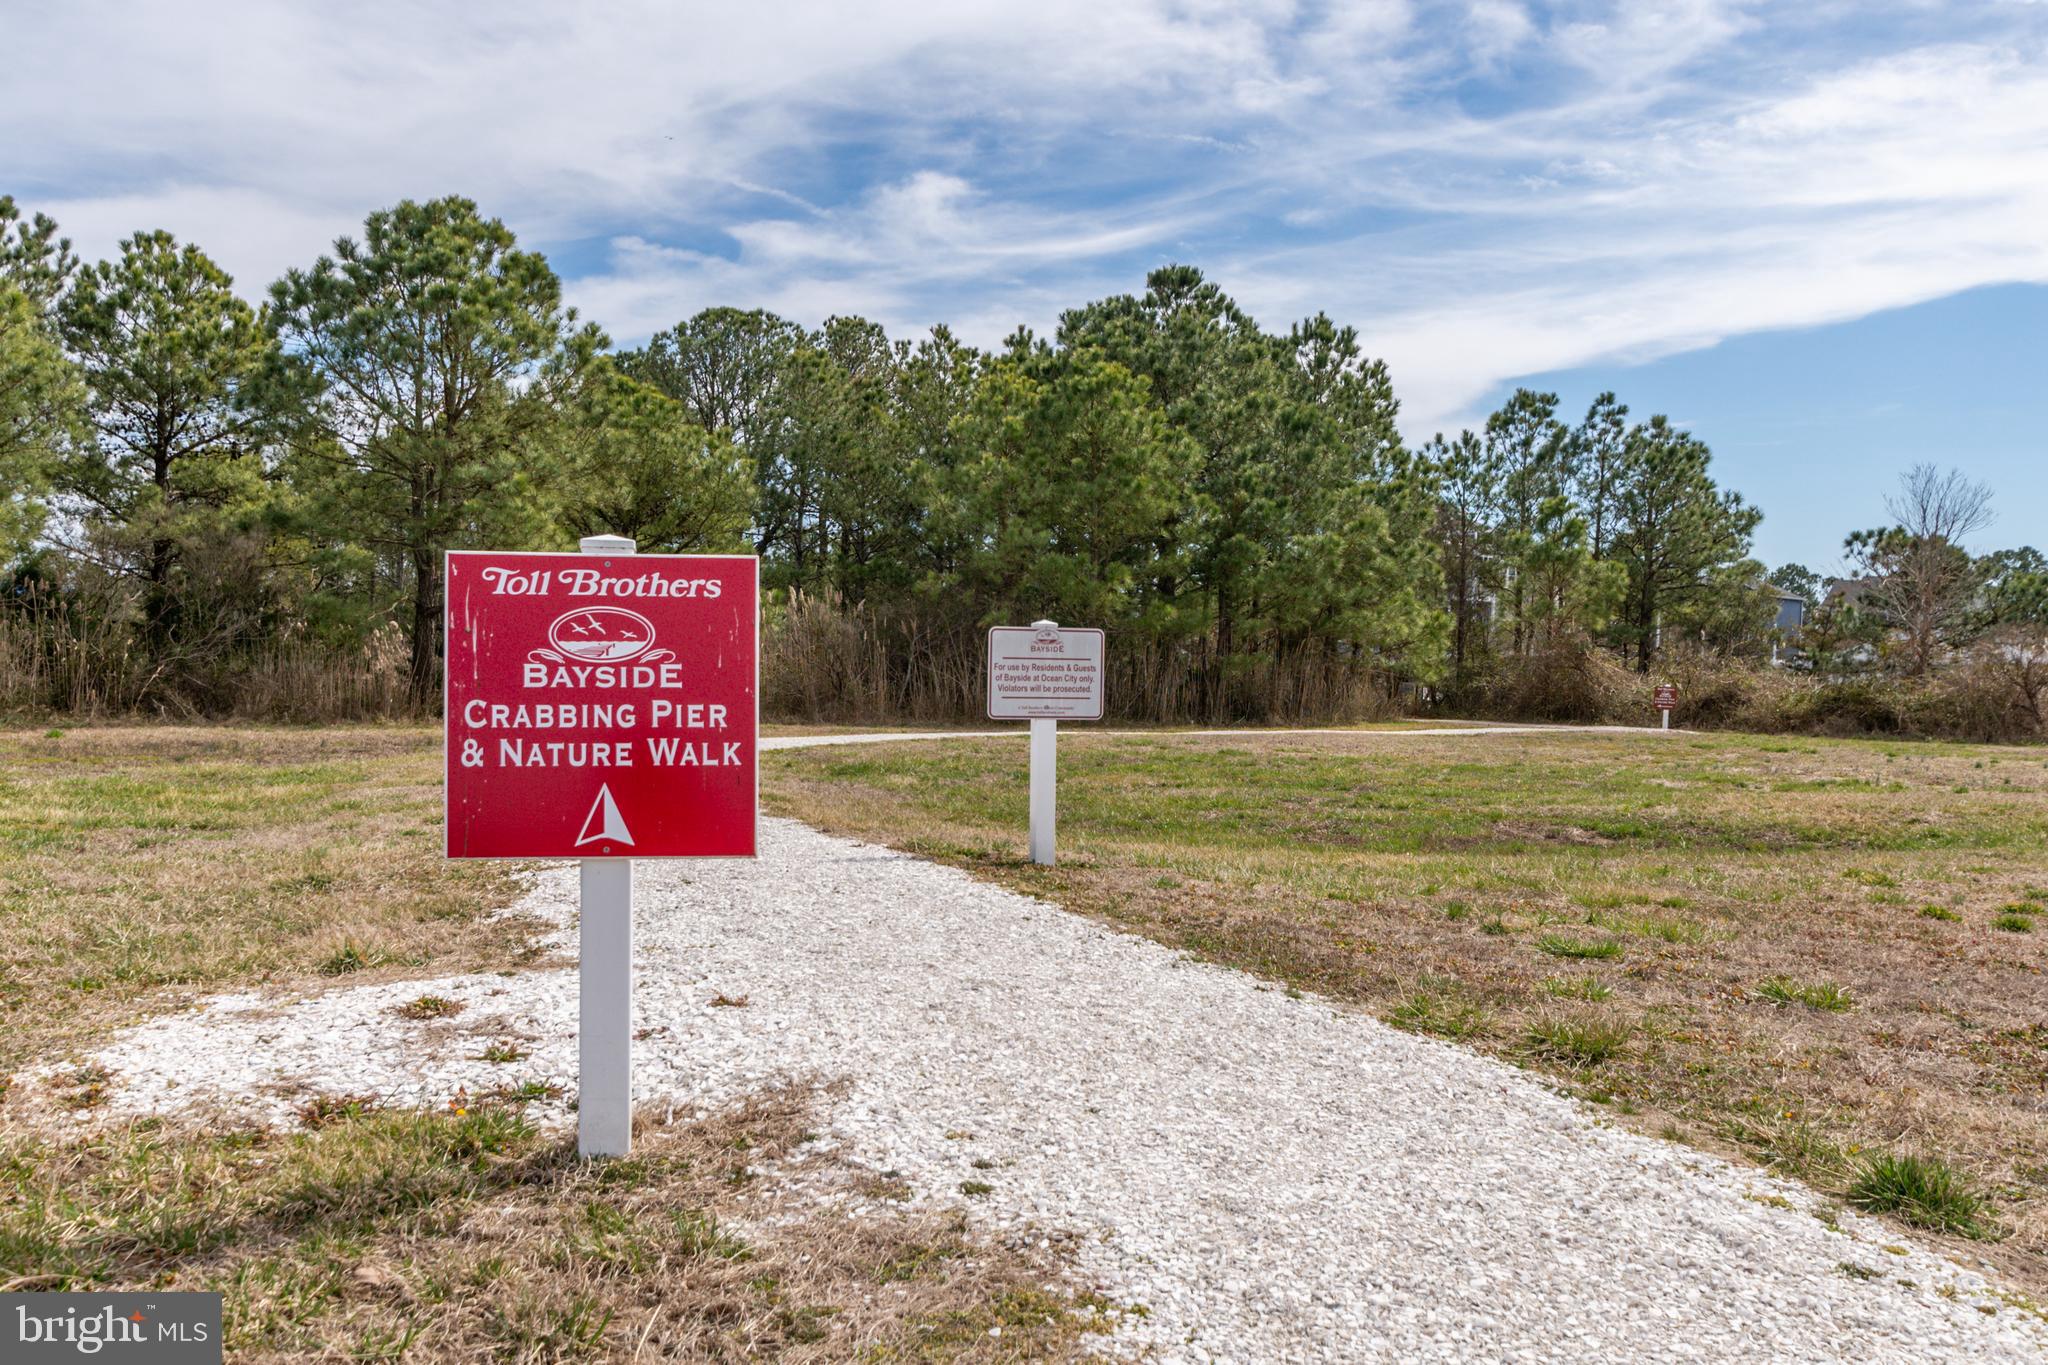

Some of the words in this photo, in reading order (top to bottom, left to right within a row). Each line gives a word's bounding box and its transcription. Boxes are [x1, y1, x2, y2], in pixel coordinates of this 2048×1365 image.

[482, 566, 551, 596] Toll
[558, 569, 721, 598] Brothers
[1030, 645, 1064, 653] BAYSIDE
[523, 663, 683, 688] BAYSIDE
[993, 662, 1006, 671] For
[1021, 663, 1029, 673] by
[1031, 663, 1065, 672] Residents
[1066, 664, 1072, 672] &
[1073, 664, 1097, 672] Guests
[995, 673, 1002, 681] of
[1003, 673, 1031, 683] Bayside
[1032, 674, 1040, 682] at
[1041, 673, 1063, 682] Ocean
[1064, 674, 1077, 684] City
[1078, 674, 1095, 685] only.
[997, 684, 1028, 692] Violators
[1029, 684, 1042, 692] will
[1042, 684, 1051, 692] be
[1052, 685, 1092, 694] prosecuted.
[464, 699, 636, 729] CRABBING
[651, 699, 727, 729] PIER
[460, 738, 483, 768] &
[499, 738, 633, 768] NATURE
[647, 737, 742, 767] WALK
